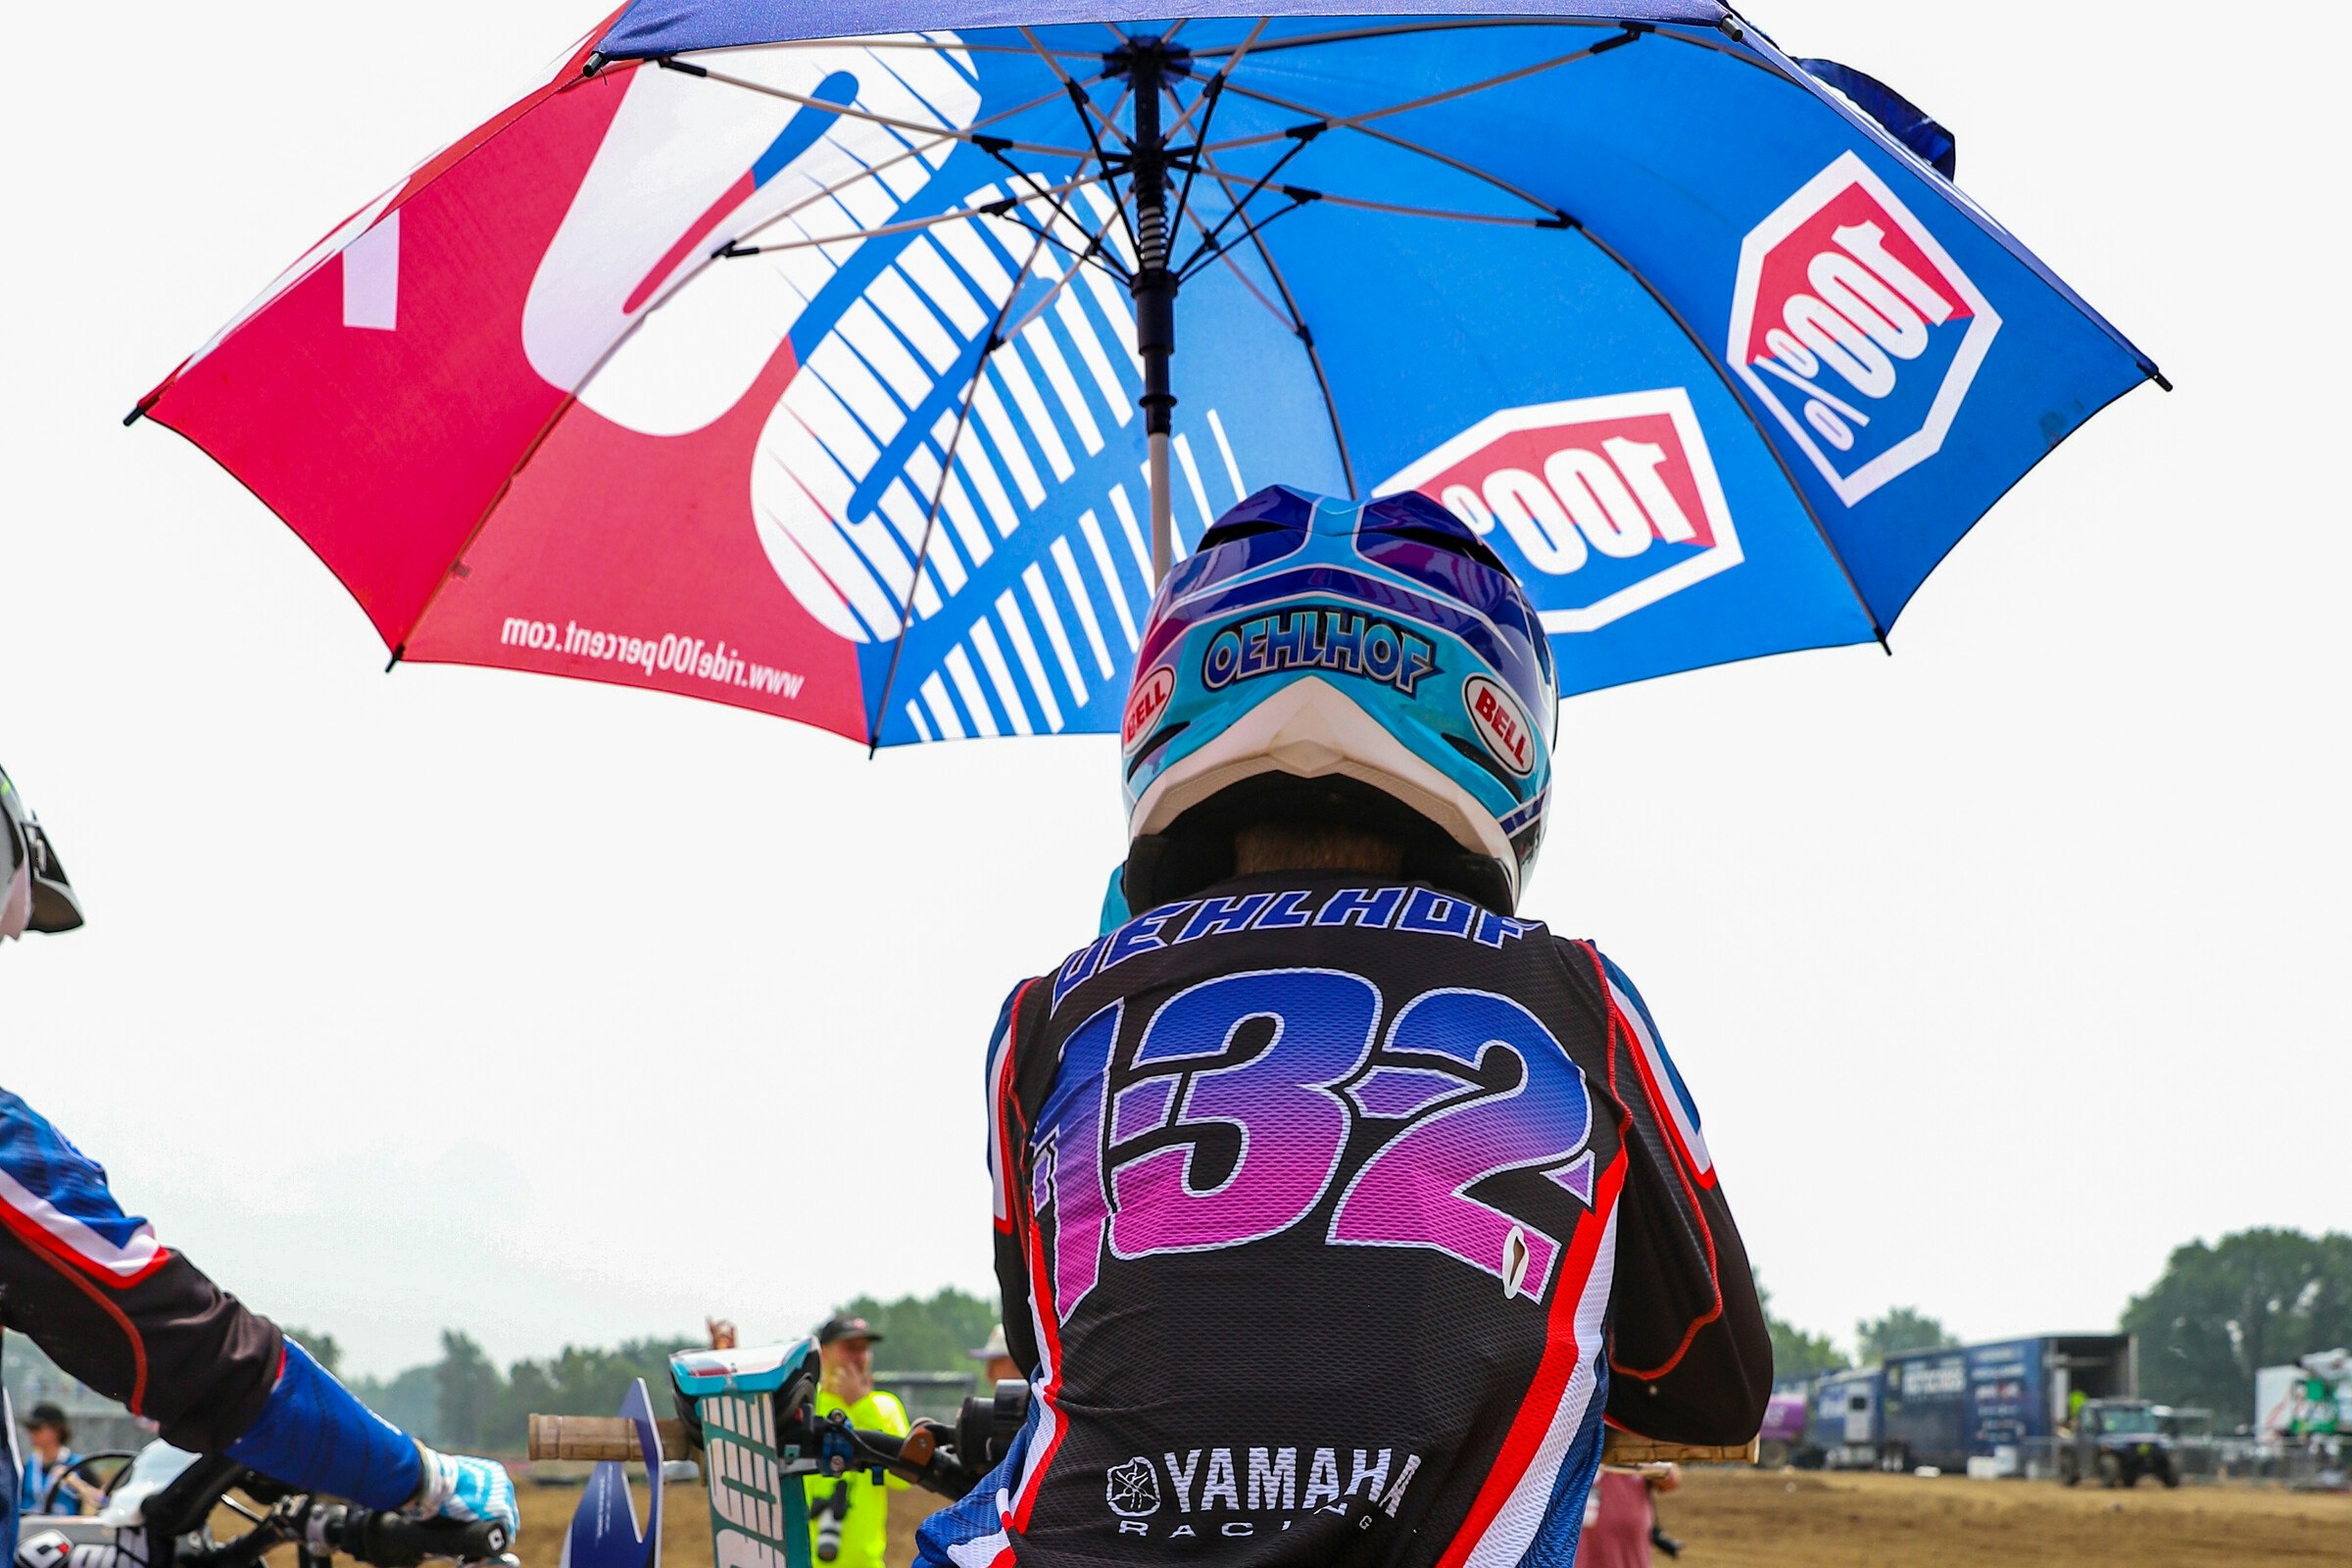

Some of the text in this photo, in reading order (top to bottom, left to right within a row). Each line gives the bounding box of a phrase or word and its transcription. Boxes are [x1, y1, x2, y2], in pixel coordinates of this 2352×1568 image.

[1201, 609, 1439, 697] OEHLHOF
[1127, 680, 1168, 744] BELL
[1475, 686, 1526, 769] BELL
[1031, 967, 1596, 1329] 132
[1163, 1446, 1421, 1518] YAMAHA
[1117, 1515, 1373, 1539] RACG
